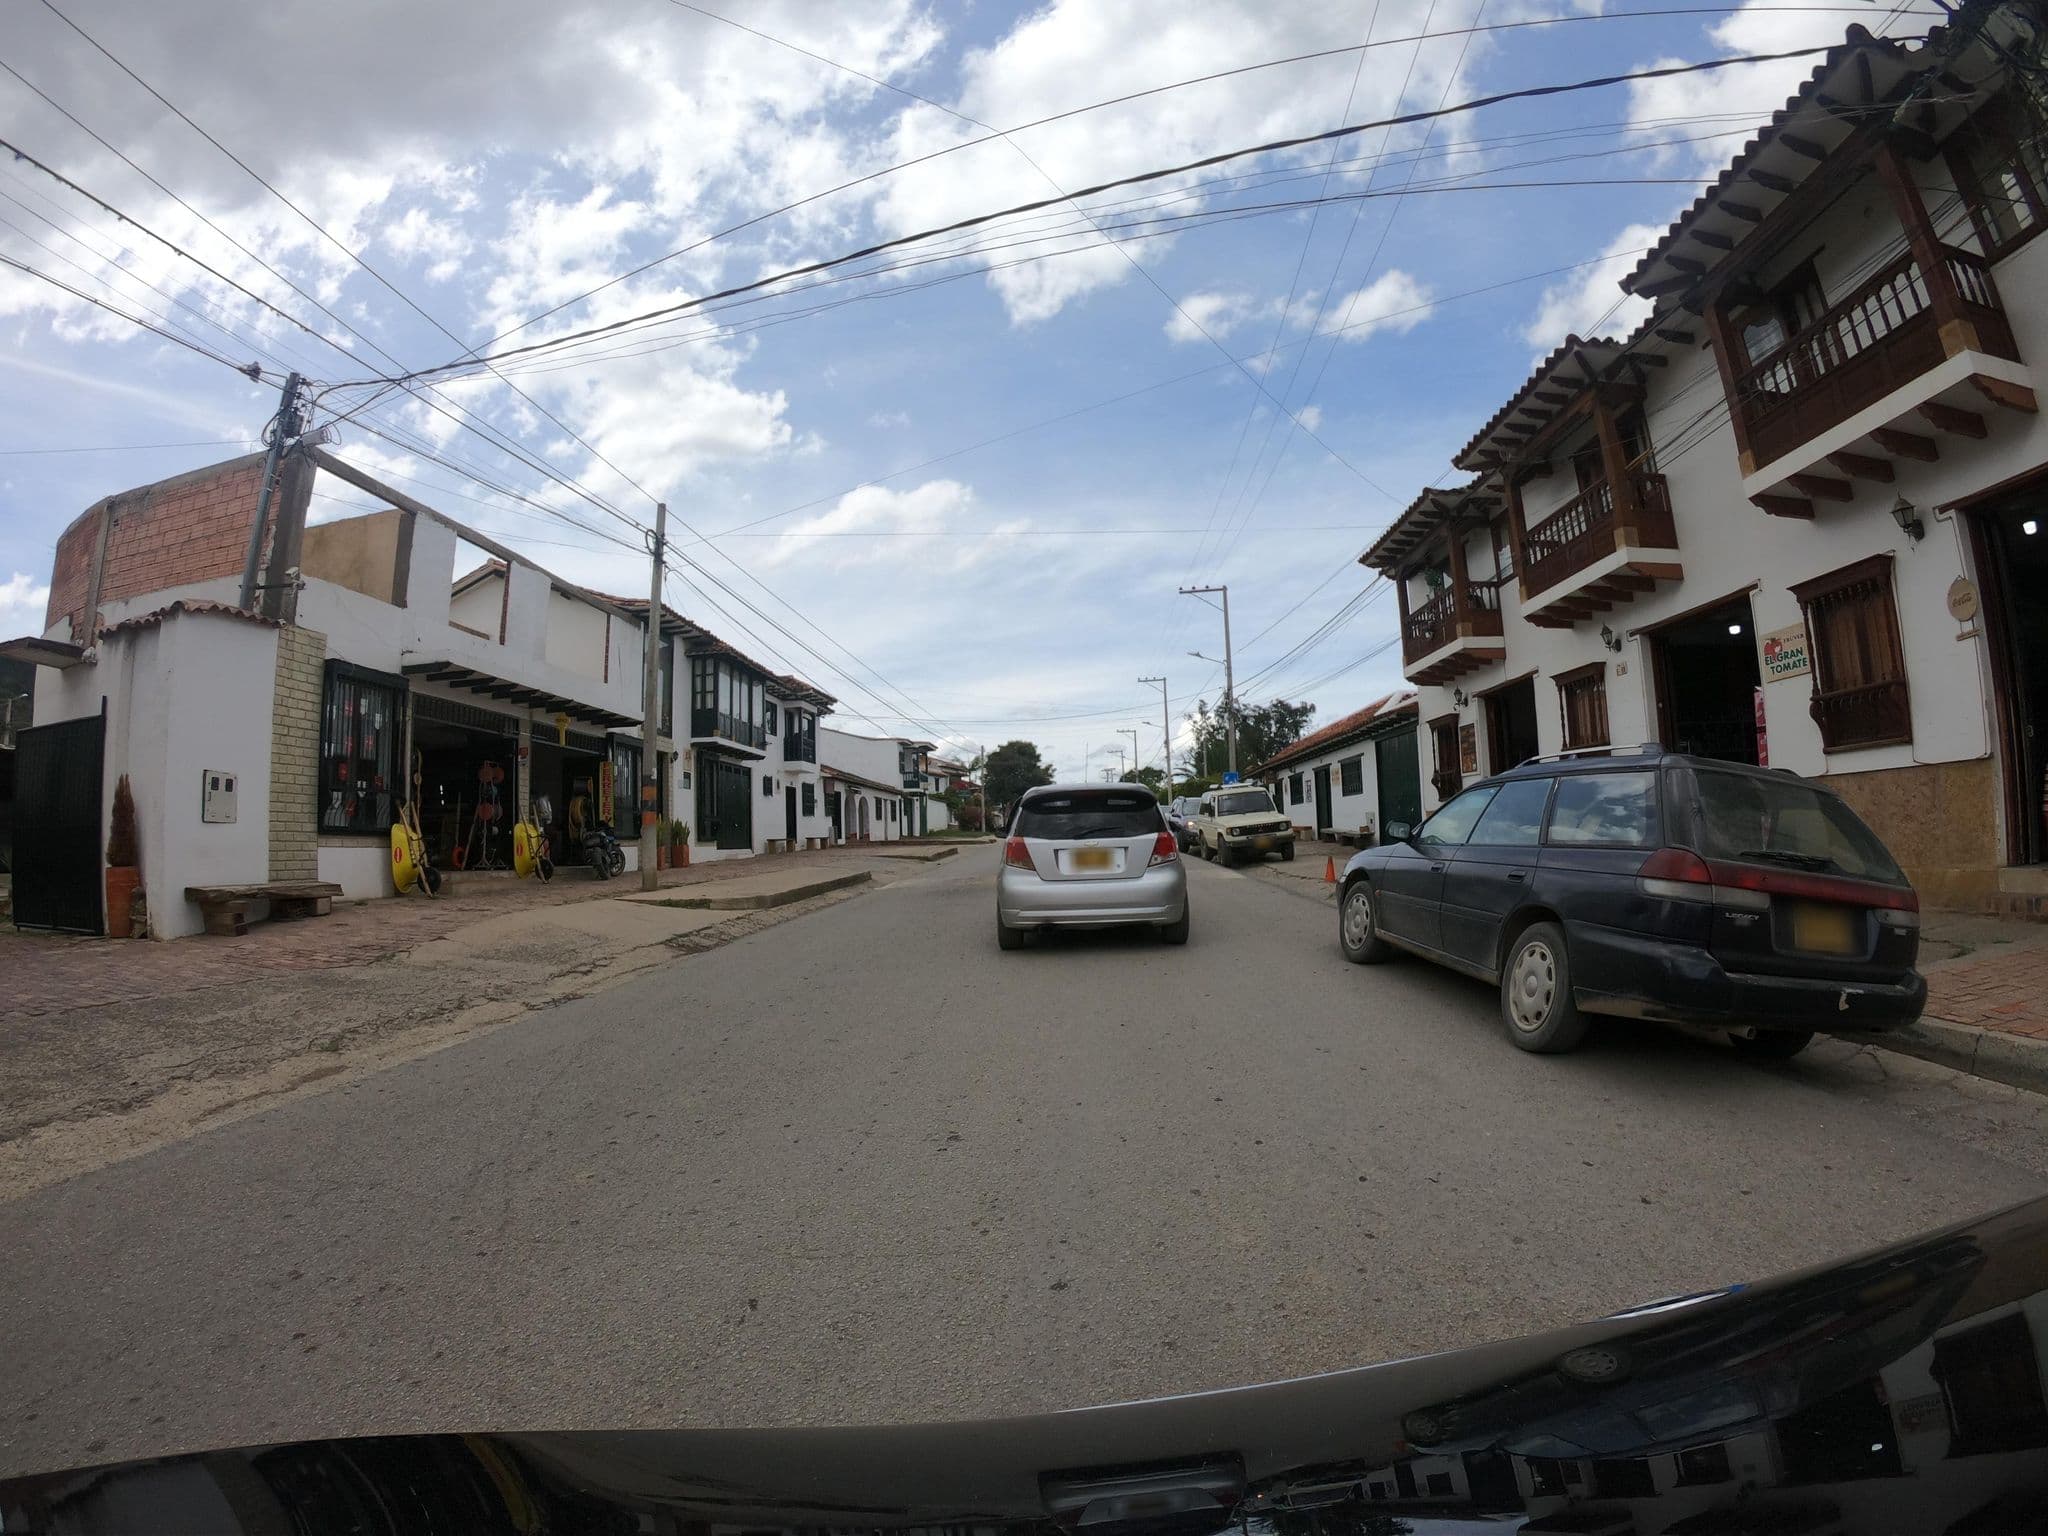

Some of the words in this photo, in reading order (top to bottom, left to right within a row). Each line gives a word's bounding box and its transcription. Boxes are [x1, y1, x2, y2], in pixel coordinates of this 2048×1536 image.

[1764, 655, 1775, 666] EL
[1776, 647, 1803, 662] GRAN
[1770, 657, 1808, 675] TOMATE
